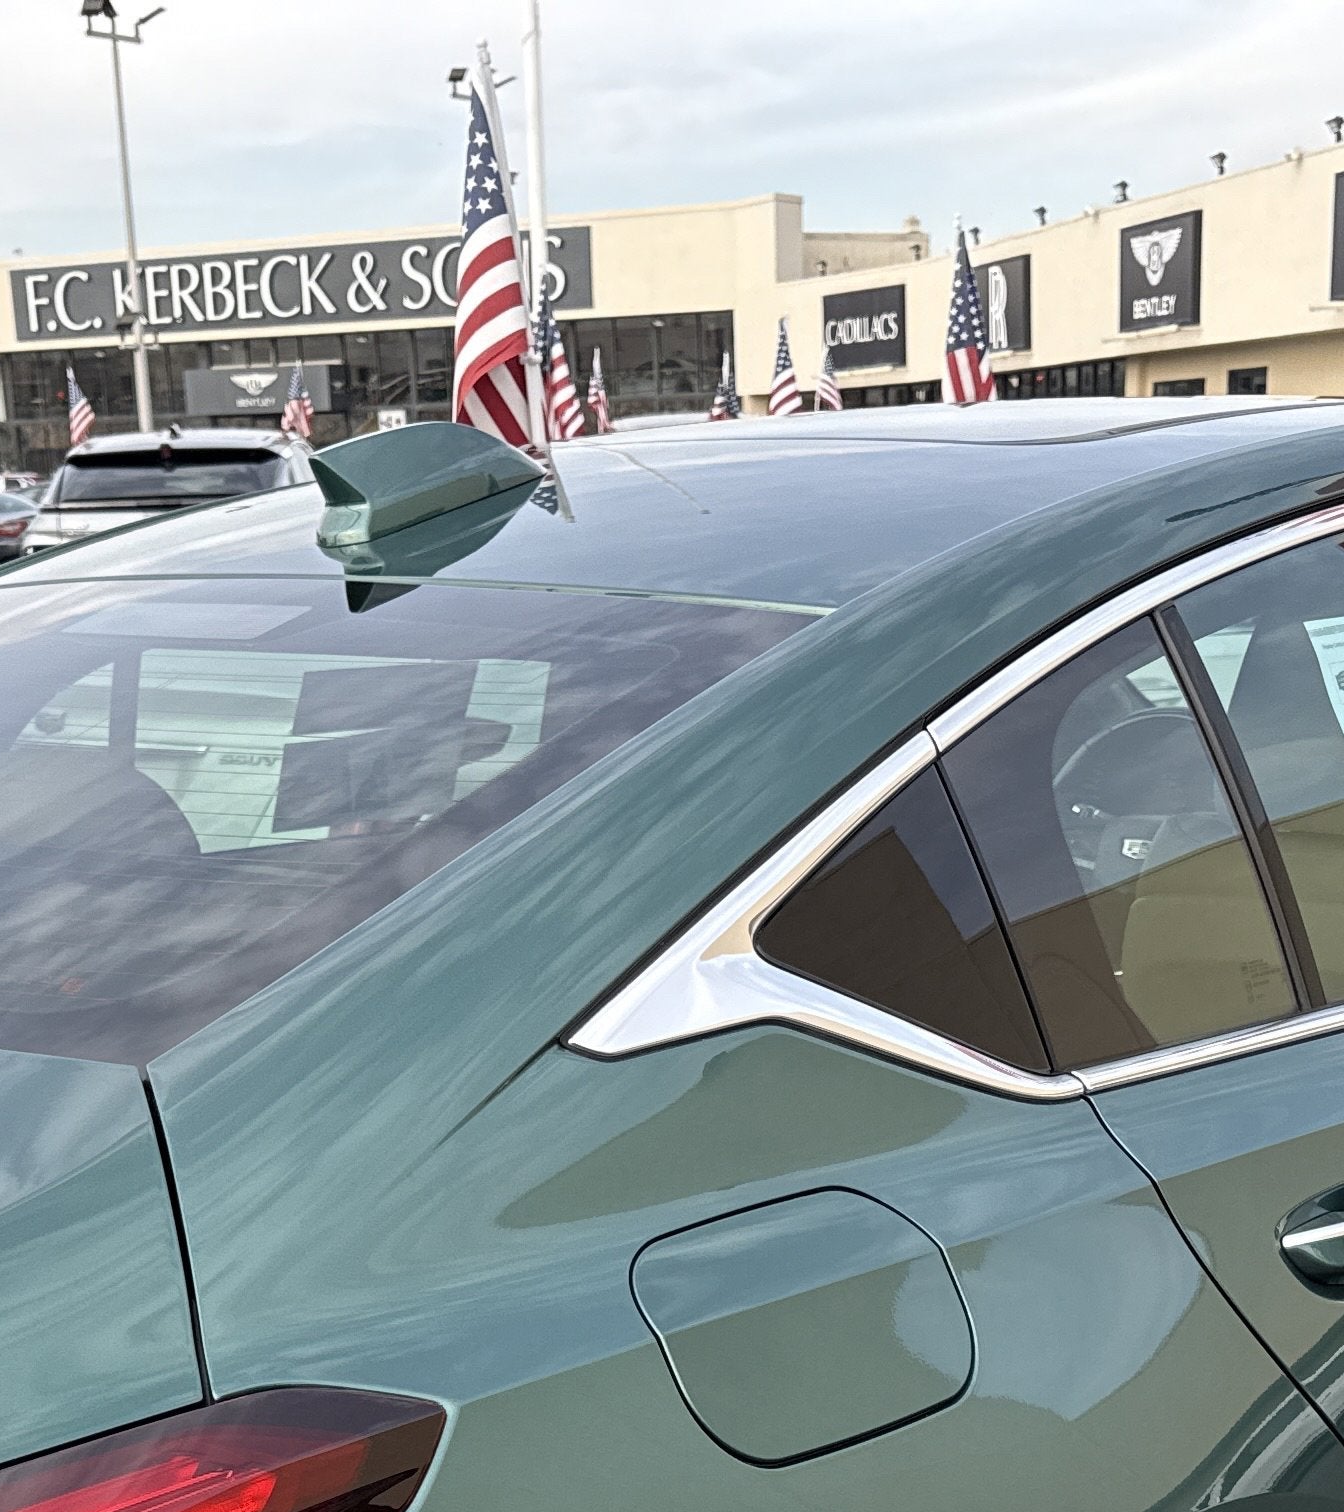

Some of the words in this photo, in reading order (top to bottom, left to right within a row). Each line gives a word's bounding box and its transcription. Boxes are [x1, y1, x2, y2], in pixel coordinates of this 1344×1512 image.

[24, 269, 103, 333] F.C.
[112, 252, 337, 326] KERBECK
[347, 251, 387, 313] &
[1133, 294, 1176, 320] BENTLEY
[825, 311, 899, 347] CADILLACS
